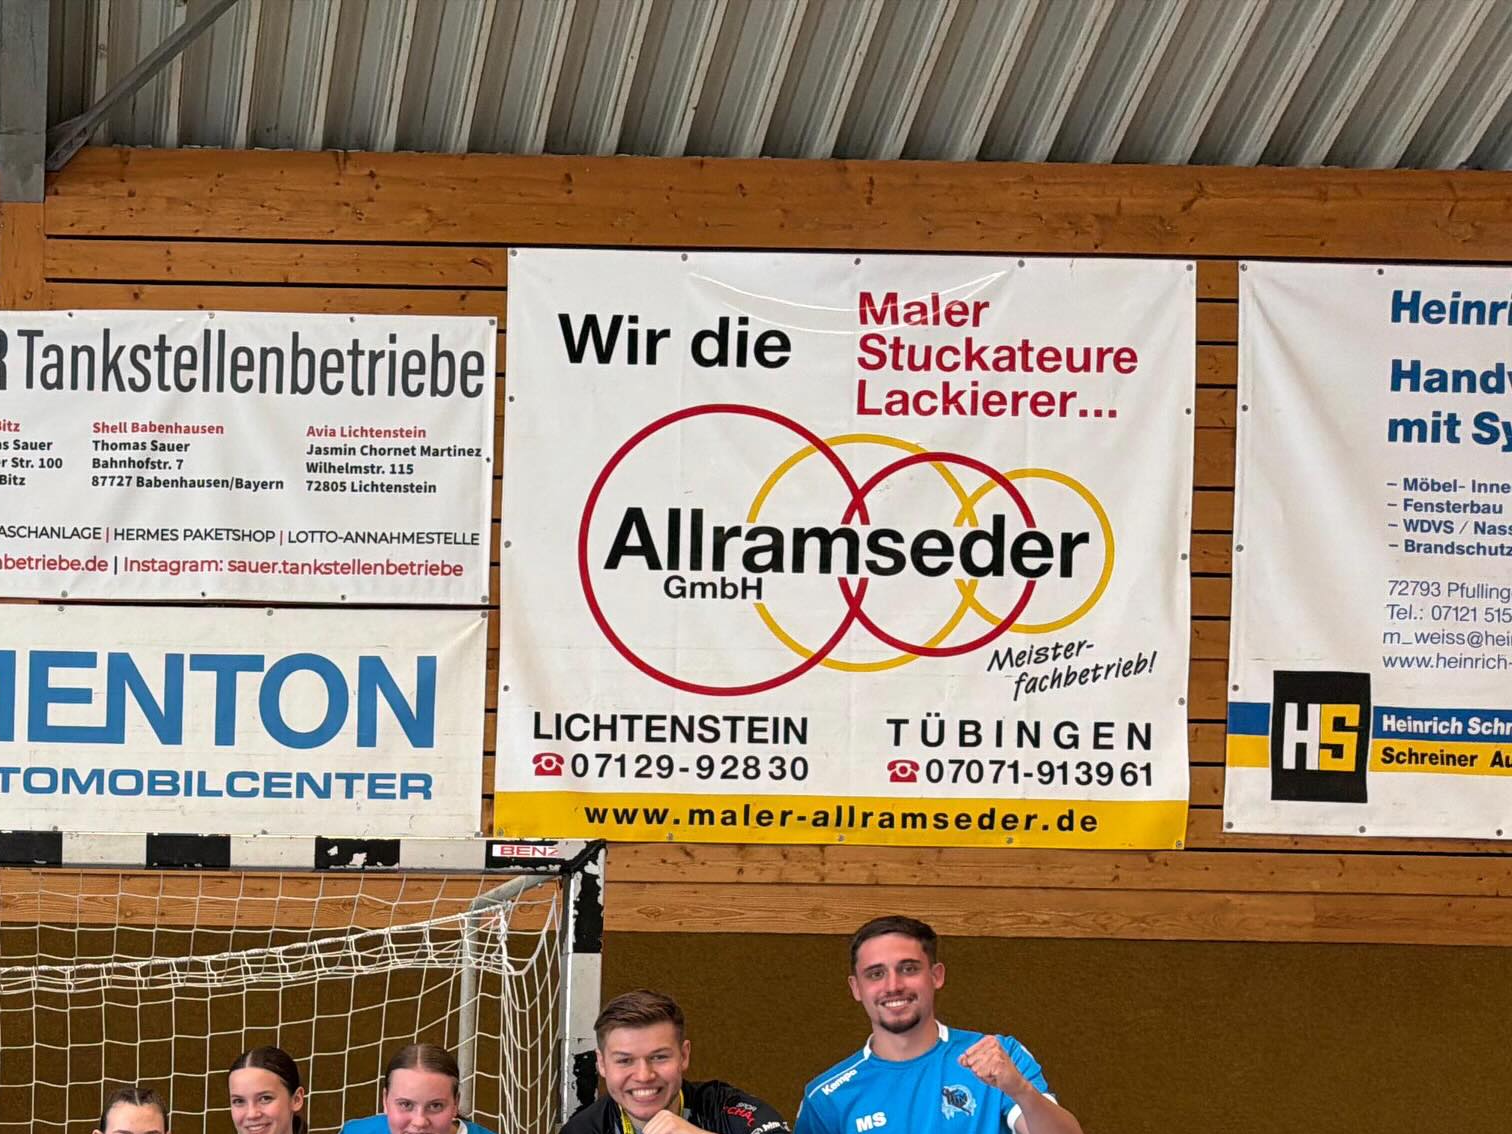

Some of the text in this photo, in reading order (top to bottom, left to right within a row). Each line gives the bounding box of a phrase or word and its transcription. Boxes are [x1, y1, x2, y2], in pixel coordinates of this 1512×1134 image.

[859, 291, 990, 328] Maler
[557, 313, 792, 369] Wir die
[17, 327, 485, 399] Tankstellenbetriebe
[857, 332, 1138, 375] Stuckateure
[1391, 359, 1512, 394] Hand
[856, 379, 1117, 418] Lackierer...
[92, 420, 224, 435] Shell Babenhausen
[306, 424, 427, 439] Avia Lichtenstein
[1388, 411, 1461, 443] mit
[12, 438, 53, 451] Sauer
[92, 439, 191, 452] Thomas Sauer
[306, 443, 482, 458] Jasmin Chornet Martinez
[11, 456, 35, 469] Str.
[38, 457, 63, 469] 100
[92, 456, 184, 470] Bahnhofstr. 7
[305, 461, 414, 475] Wilhelmstr. 115
[91, 475, 284, 493] 87727 Babenhausen/Bayern
[305, 479, 437, 494] 72805 Lichtenstein
[1403, 477, 1511, 493] Möbel- Inne
[1403, 499, 1503, 514] Fensterbau
[113, 527, 179, 542] HERMES
[183, 527, 276, 543] PAKETSHOP
[288, 530, 480, 546] LOTTO-ANNAHMESTELLE
[1403, 519, 1454, 534] WDVS
[603, 505, 1089, 579] Allramseder
[1404, 540, 1512, 556] Brandschutz
[124, 556, 224, 576] Instagram:
[227, 558, 464, 577] sauer.tankstellenbetriebe
[663, 575, 763, 601] GmbH
[1388, 580, 1512, 603] 72793 Pfulling
[1386, 604, 1512, 623] Tel.: 07121 515
[1383, 629, 1512, 648] m_weiss@hei
[987, 638, 1095, 673] Meister-
[1012, 651, 1157, 700] fachbetrieb!
[533, 711, 808, 745] LICHTENSTEIN
[886, 712, 1152, 751] TÜBINGEN
[1382, 714, 1462, 735] Heinrich
[1283, 703, 1360, 772] HS
[571, 753, 809, 780] 07129-92830
[1381, 747, 1478, 767] Schreiner
[925, 759, 1153, 786] 07071-913961
[584, 806, 1098, 831] www.maler-allramseder.de
[821, 1069, 858, 1095] Kempa
[856, 1111, 887, 1133] MS
